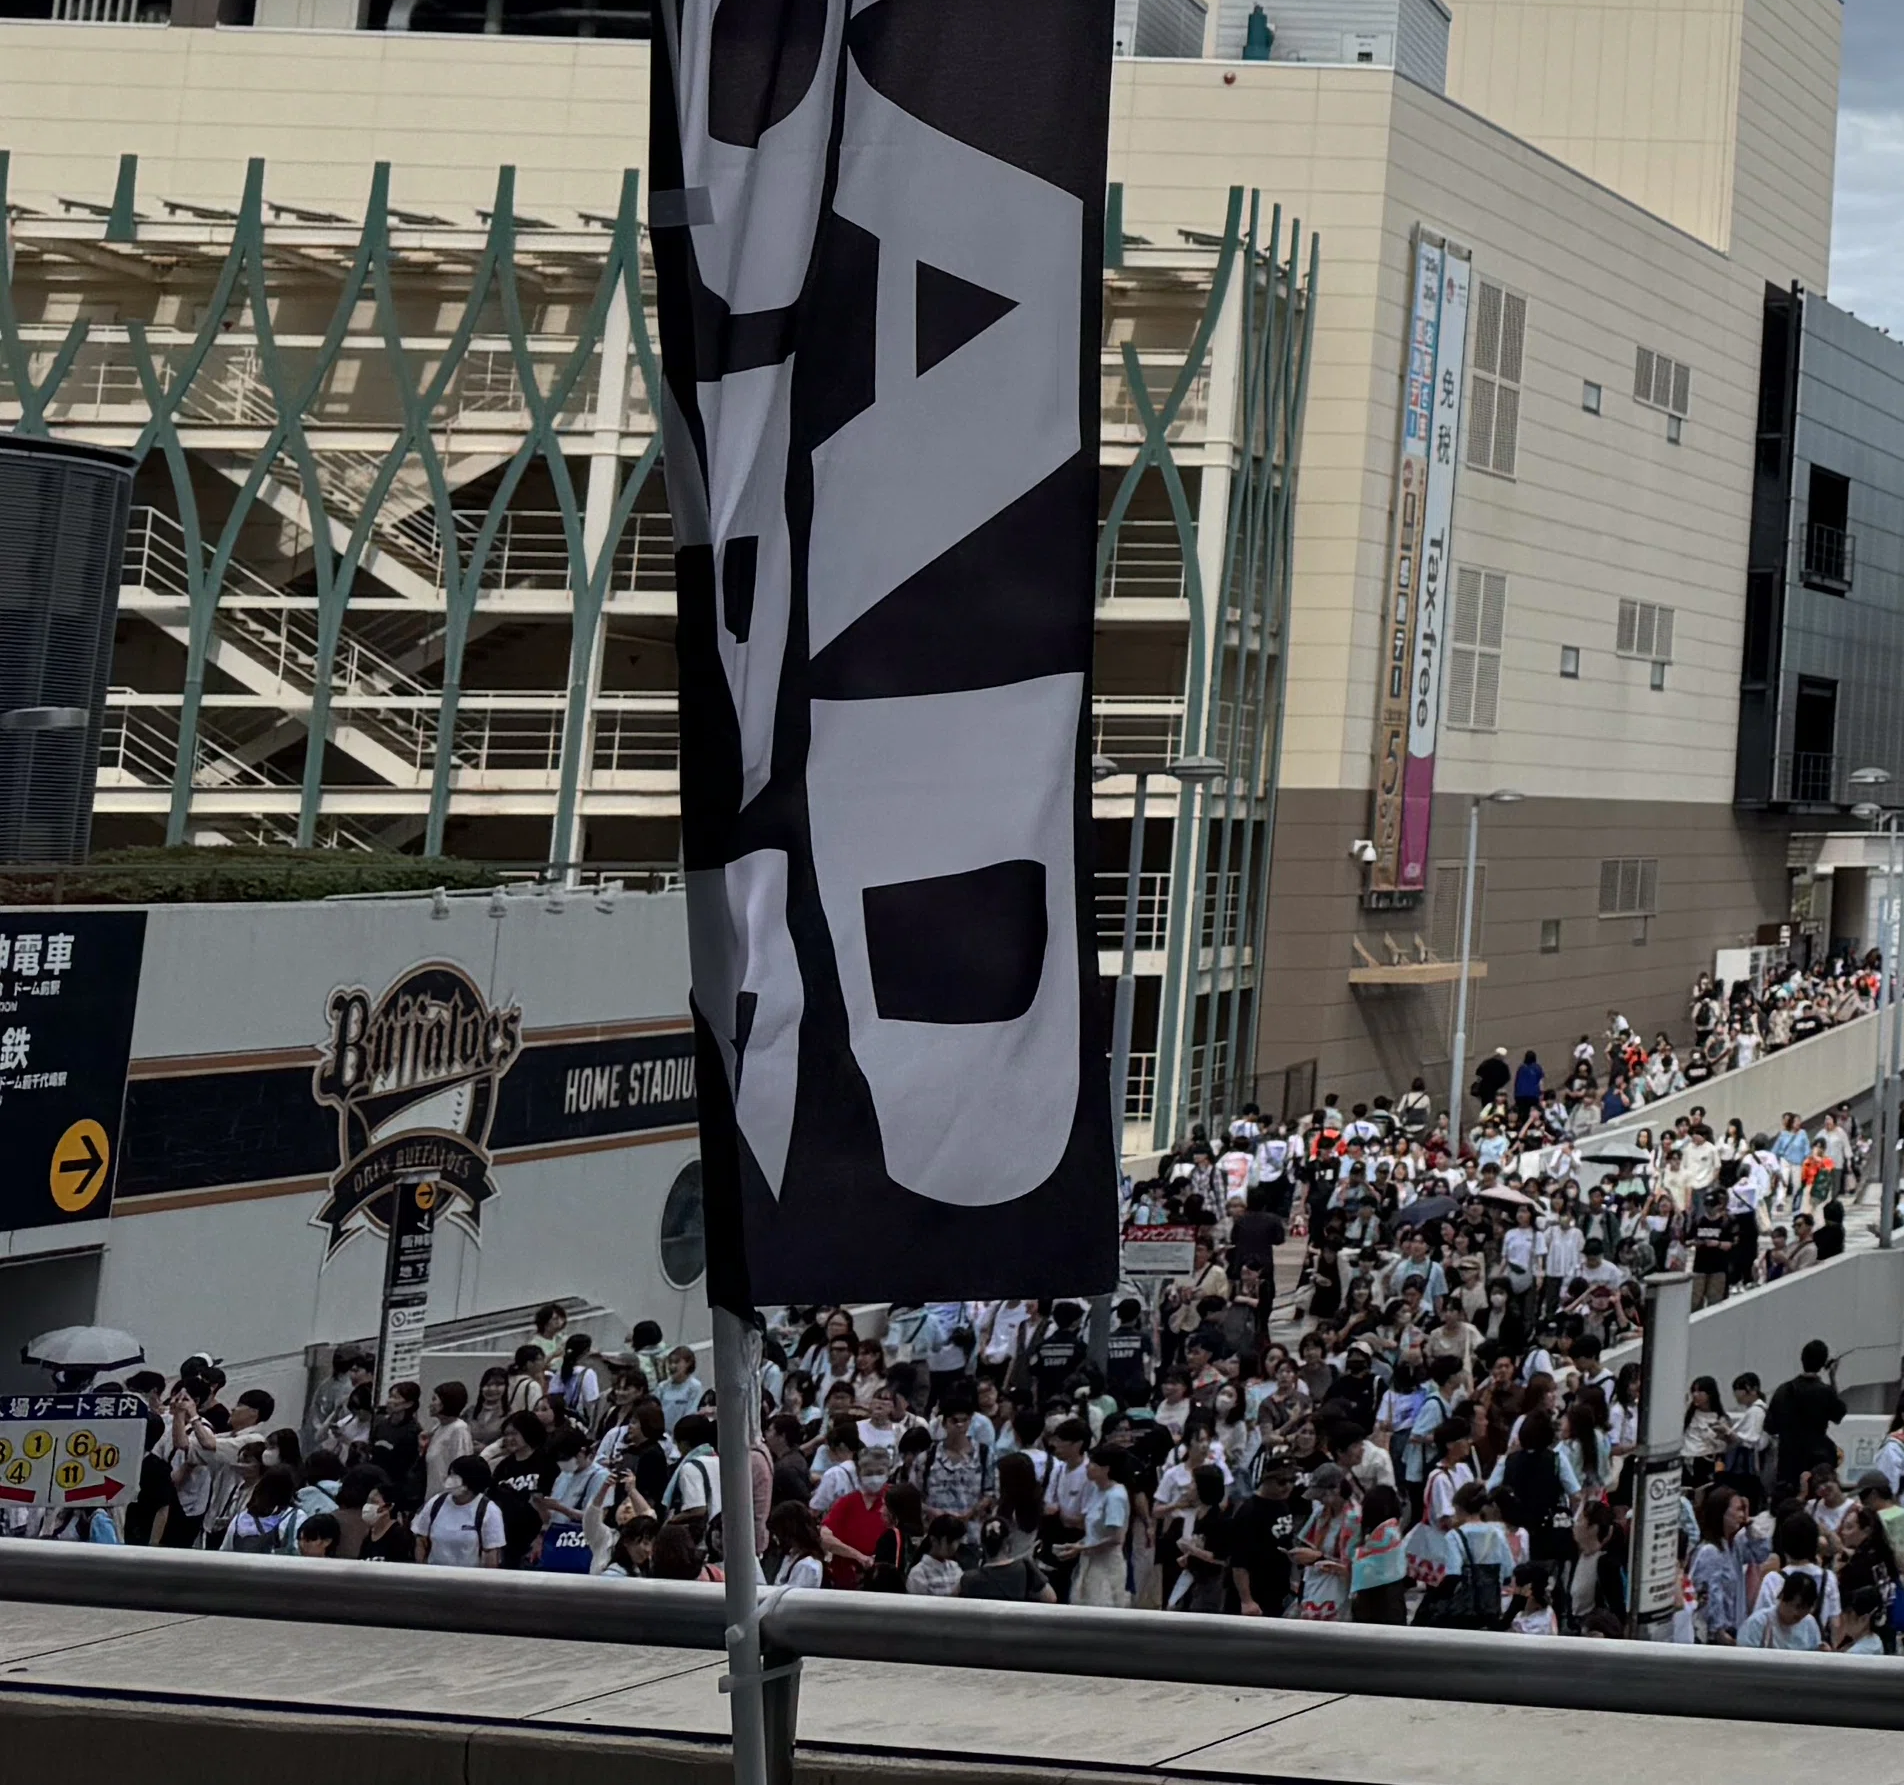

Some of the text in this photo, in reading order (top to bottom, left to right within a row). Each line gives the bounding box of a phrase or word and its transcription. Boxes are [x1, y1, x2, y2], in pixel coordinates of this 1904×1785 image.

[1436, 368, 1455, 465] 免税
[1416, 526, 1446, 729] Tax-free
[318, 987, 521, 1099] Buffaloes
[564, 1057, 697, 1114] HOME STADIU
[353, 1139, 471, 1193] ORIX BUFFALOES
[73, 1434, 90, 1455] 6
[94, 1447, 116, 1468] 10
[9, 1462, 80, 1484] 4 11
